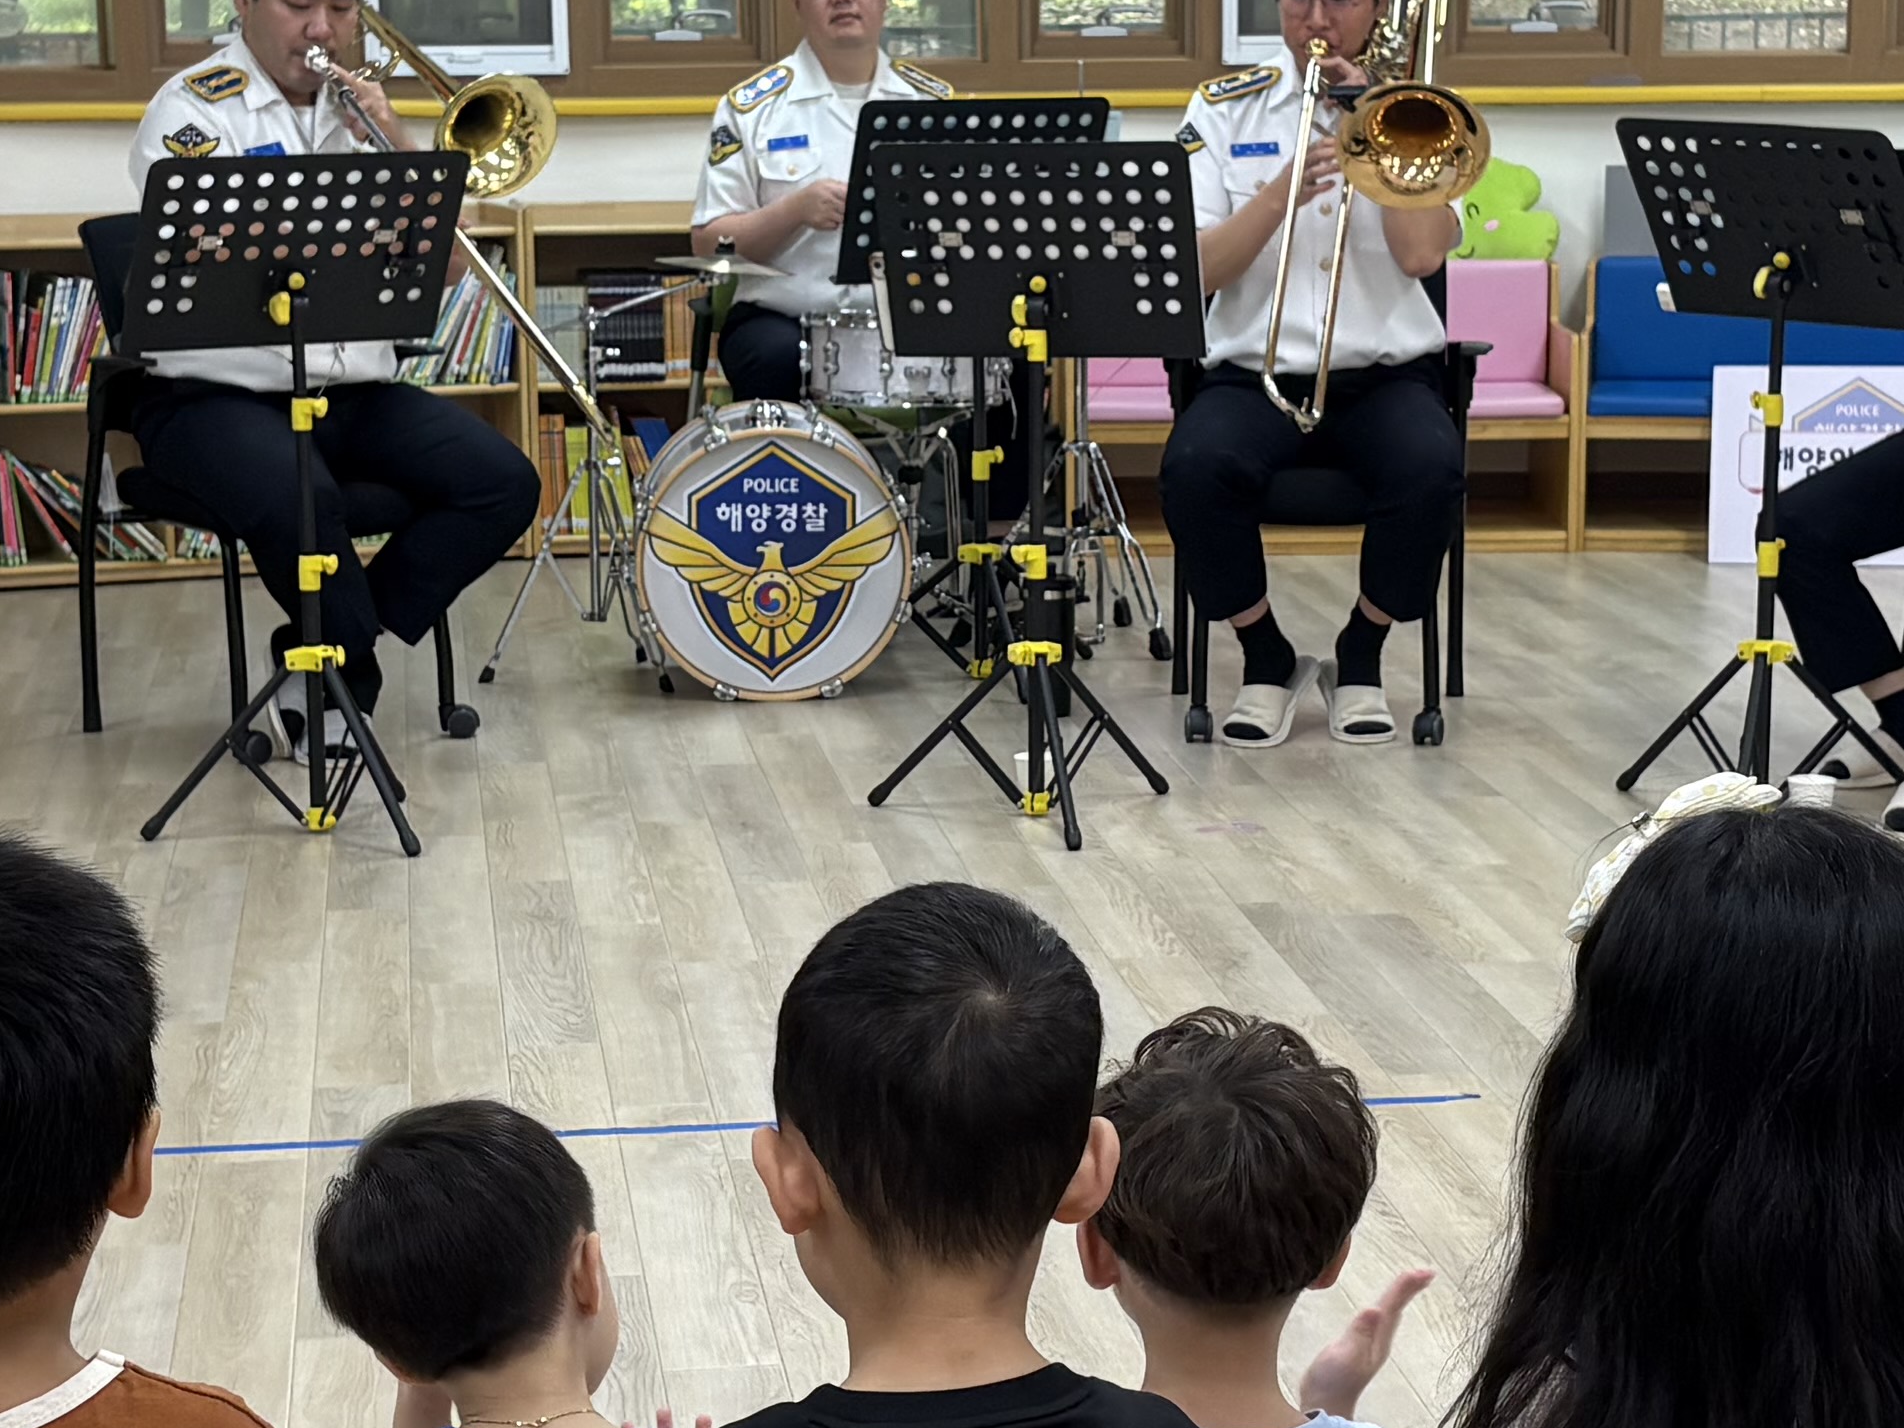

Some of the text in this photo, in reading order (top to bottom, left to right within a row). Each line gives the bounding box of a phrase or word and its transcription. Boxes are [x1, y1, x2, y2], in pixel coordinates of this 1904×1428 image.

[1835, 404, 1880, 417] POLICE
[742, 477, 800, 493] POLICE
[715, 502, 829, 533] 해양경찰
